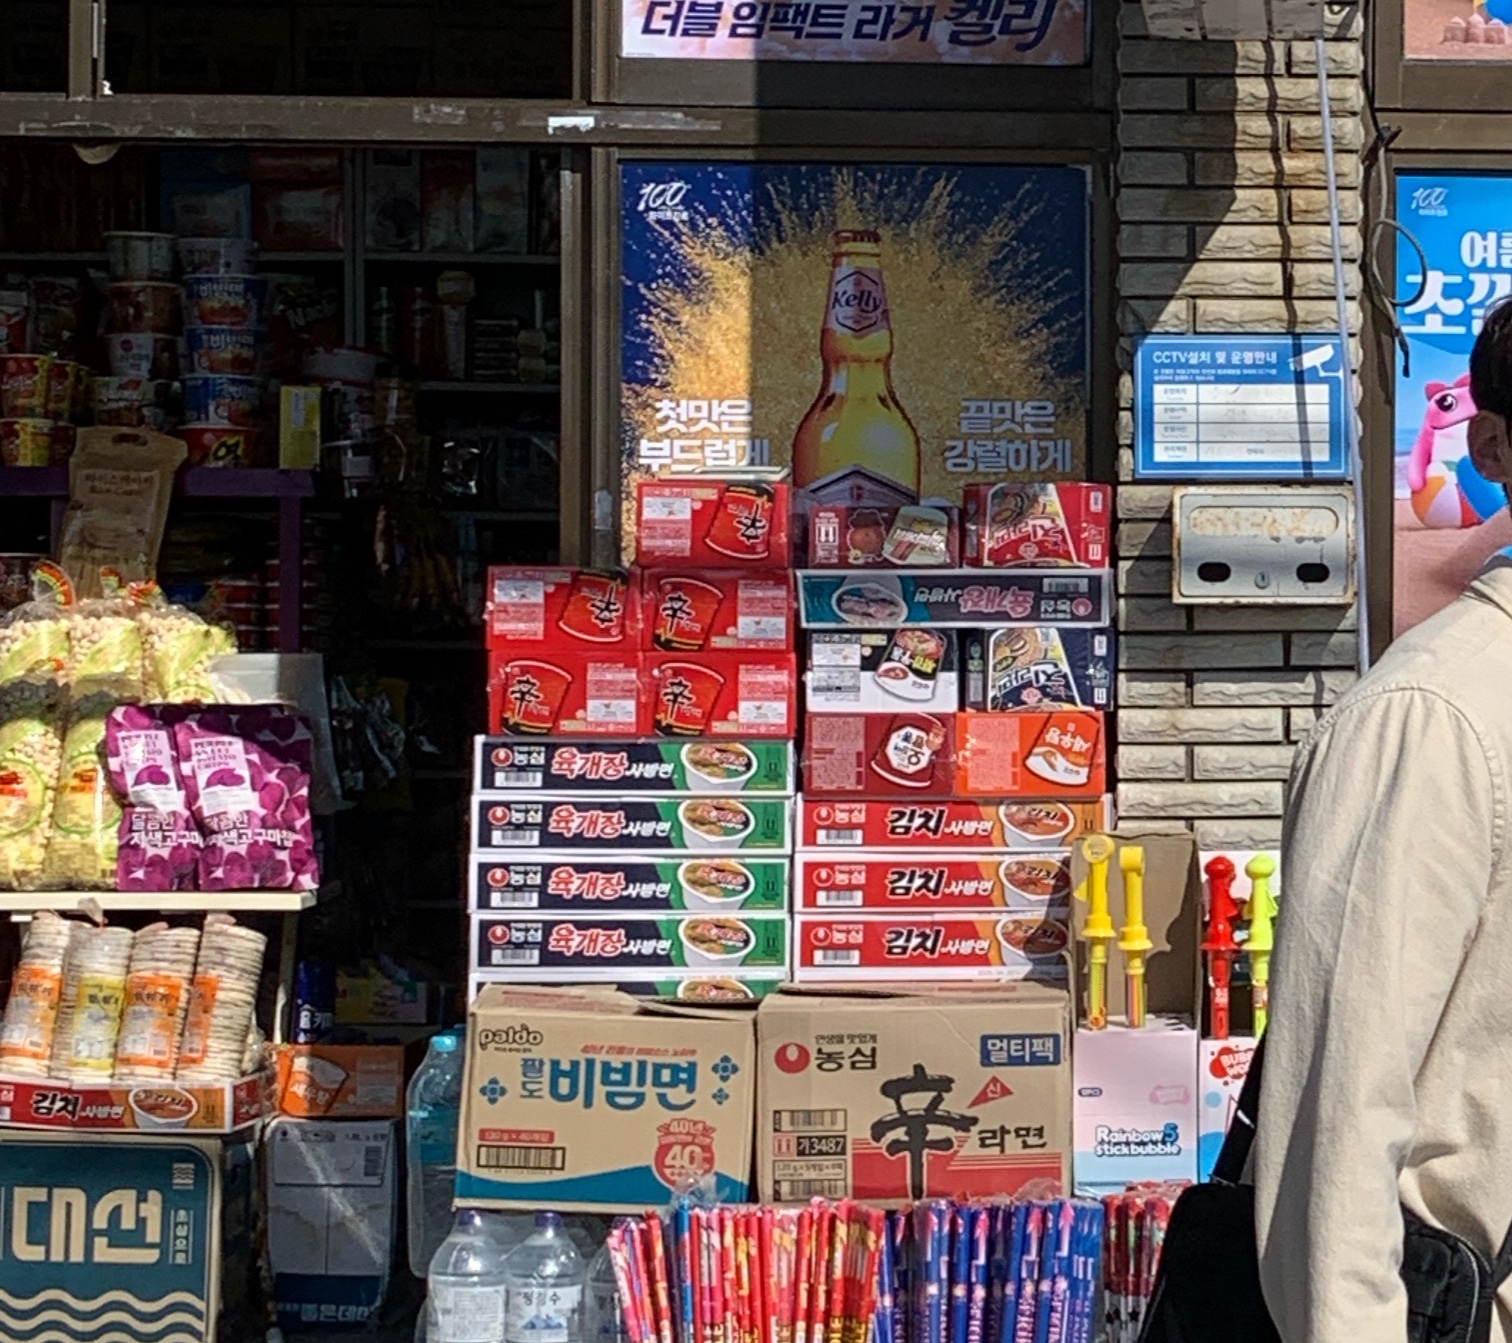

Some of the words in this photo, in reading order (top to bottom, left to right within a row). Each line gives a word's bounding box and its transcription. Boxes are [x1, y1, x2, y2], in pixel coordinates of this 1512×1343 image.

[641, 0, 722, 39] 더블
[728, 2, 849, 41] 임팩트
[853, 2, 936, 42] 라거
[637, 182, 691, 211] 100
[1412, 187, 1448, 209] 100
[832, 290, 882, 315] Kelly
[1153, 351, 1211, 365] CCTV설치
[656, 398, 752, 434] 첫맛은
[960, 400, 1056, 435] 끝맛은
[639, 440, 769, 472] 부드럽게
[945, 440, 1071, 474] 강렬하게
[959, 586, 1035, 618] 육개장
[1040, 600, 1073, 615] 농심
[1043, 725, 1092, 753] 새우탕
[513, 750, 546, 767] 농심
[551, 747, 629, 780] 육개장
[626, 762, 674, 778] 사발면
[510, 807, 543, 824] 농심
[548, 805, 626, 838] 육개장
[624, 820, 672, 837] 사발면
[835, 807, 867, 824] 농심
[887, 807, 947, 838] 김치
[943, 820, 994, 836] 사발면
[509, 869, 543, 886] 농심
[548, 866, 626, 900] 육개장
[624, 883, 672, 899] 사발면
[834, 869, 867, 885] 농심
[886, 867, 947, 899] 김치
[943, 881, 994, 896] 사발면
[509, 926, 543, 943] 농심
[548, 923, 626, 957] 육개장
[624, 939, 672, 955] 사발면
[832, 928, 864, 944] 농심
[884, 926, 945, 958] 김치
[940, 940, 990, 955] 사발면
[480, 1024, 543, 1051] paldo
[987, 1038, 1055, 1064] 멀티팩
[814, 1046, 878, 1073] 농심
[550, 1057, 698, 1111] 비빔면
[986, 1078, 1002, 1098] 신
[33, 1091, 83, 1119] 김치
[869, 1063, 980, 1201] 辛
[977, 1124, 1048, 1154] 라면
[12, 1186, 163, 1265] 대선
